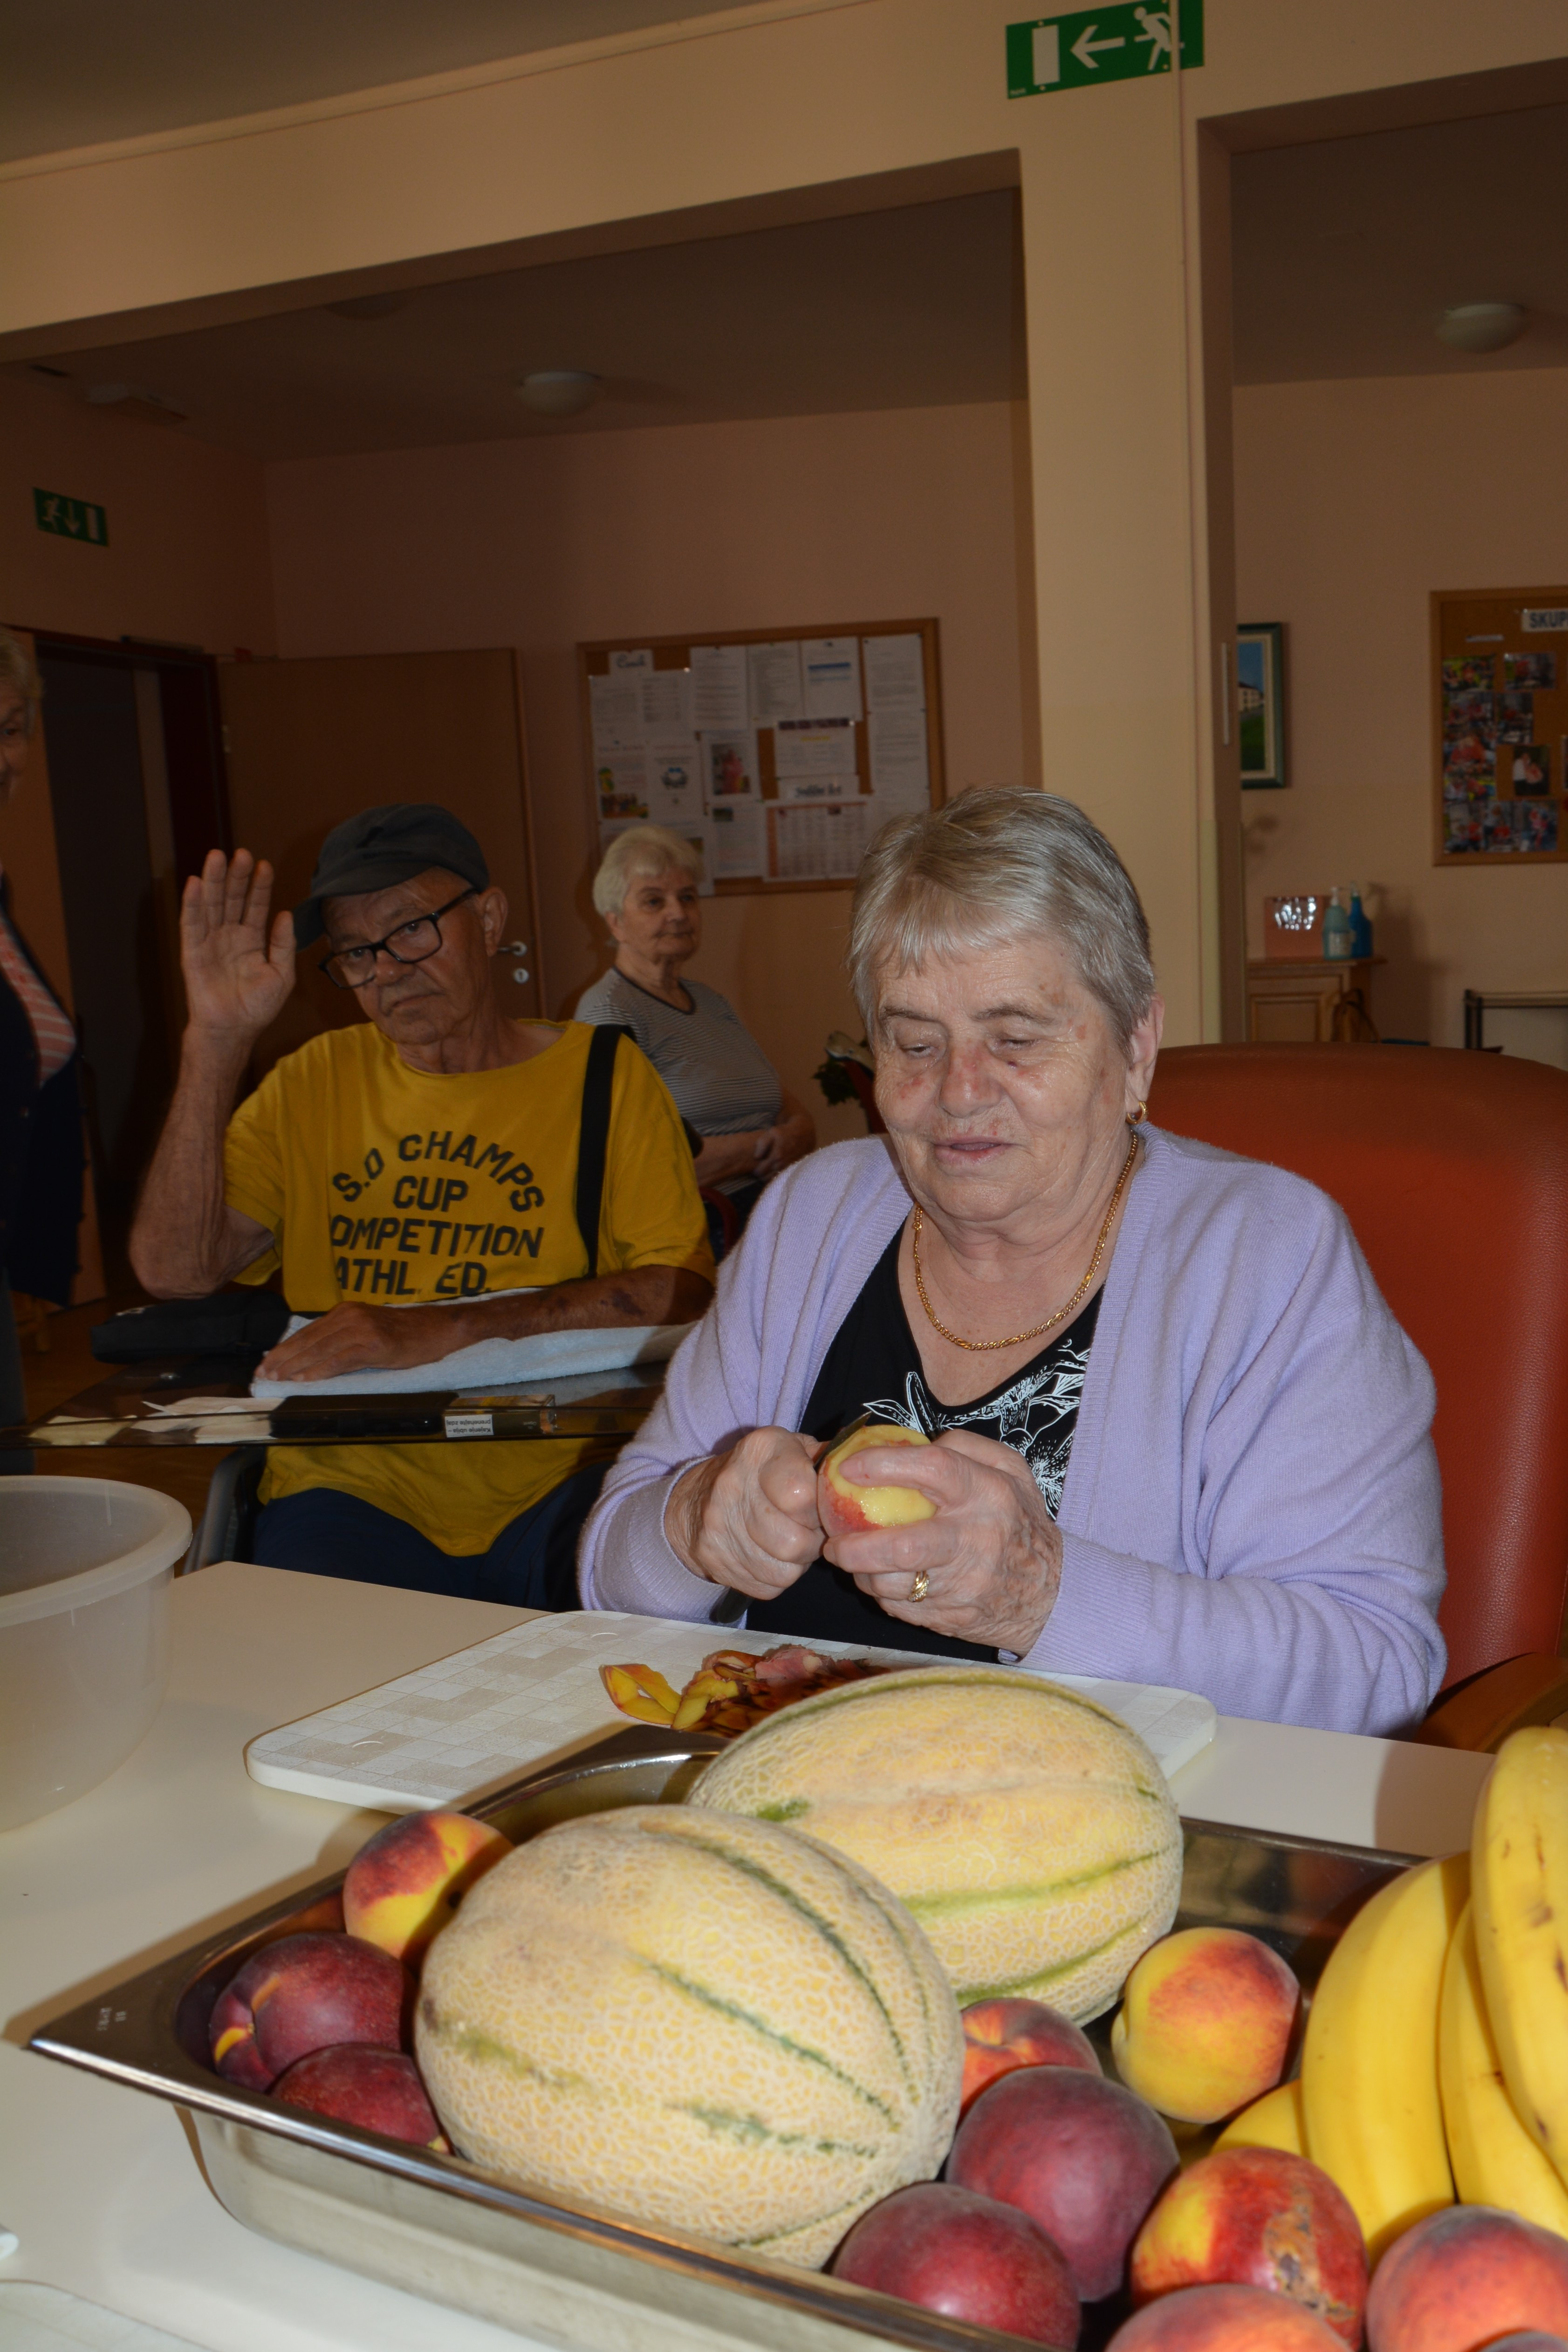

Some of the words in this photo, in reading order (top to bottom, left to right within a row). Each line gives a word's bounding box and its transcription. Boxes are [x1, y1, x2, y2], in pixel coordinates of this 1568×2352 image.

[399, 1131, 544, 1212] CHAMPS
[394, 1176, 469, 1212] CUP
[331, 1214, 544, 1258] OMPETITION
